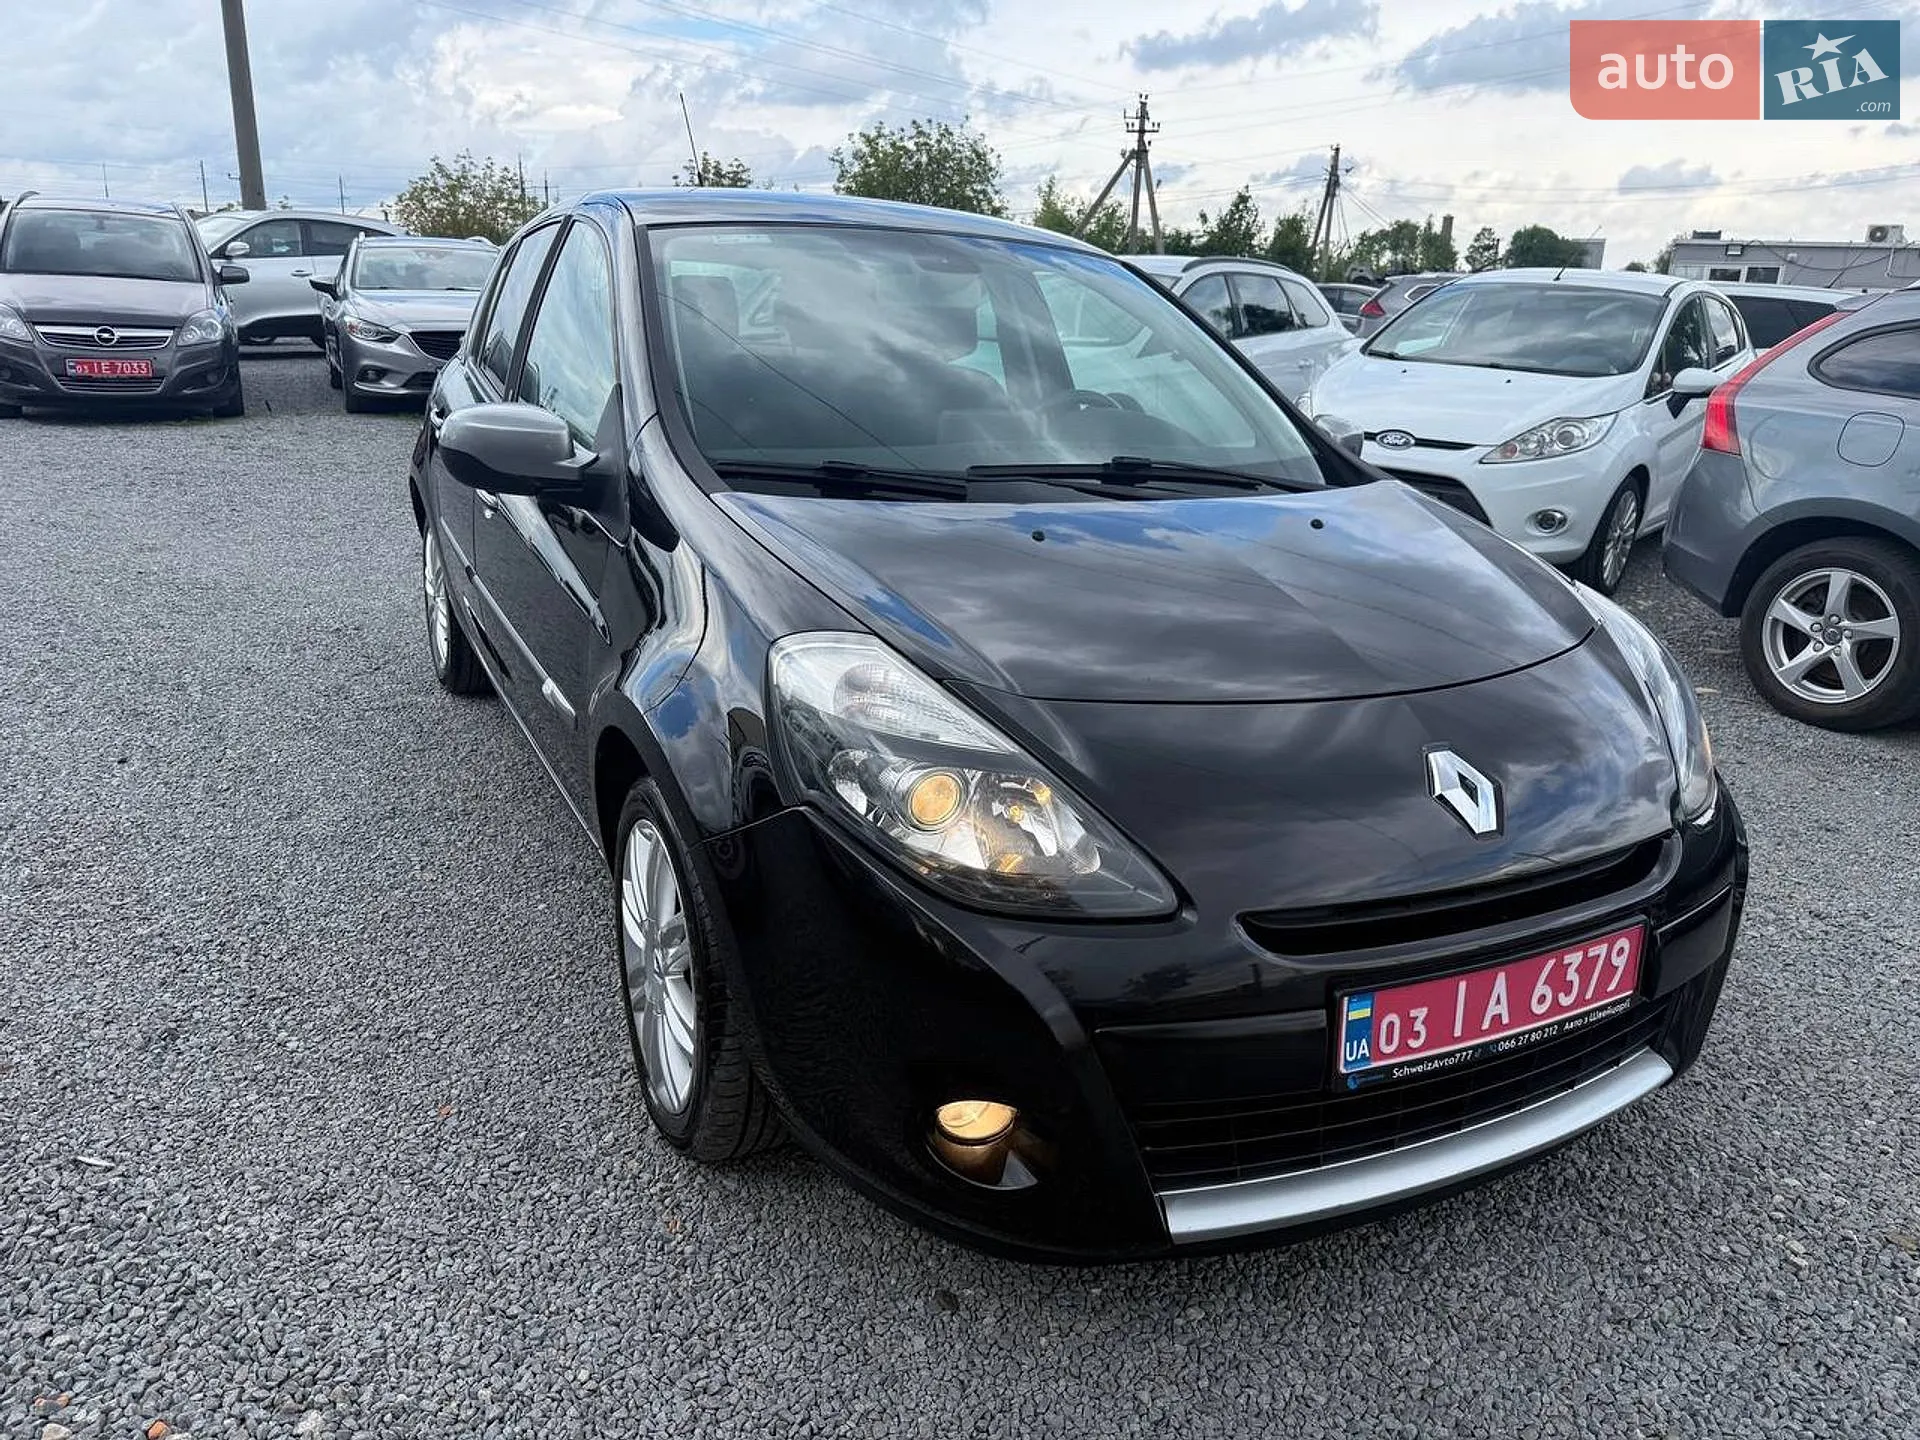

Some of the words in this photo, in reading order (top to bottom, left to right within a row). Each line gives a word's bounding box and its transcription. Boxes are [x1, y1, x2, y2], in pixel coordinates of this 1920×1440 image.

[114, 362, 147, 374] 7033
[1378, 1006, 1429, 1055] 03
[1453, 971, 1510, 1038] IA
[1529, 937, 1631, 1015] 6379
[1345, 1038, 1370, 1061] UA
[1392, 1050, 1473, 1079] SchweizAvto777
[1498, 1039, 1517, 1052] 066
[1518, 1033, 1529, 1046] 27
[1530, 1030, 1543, 1043] 80
[1543, 1025, 1559, 1039] 212
